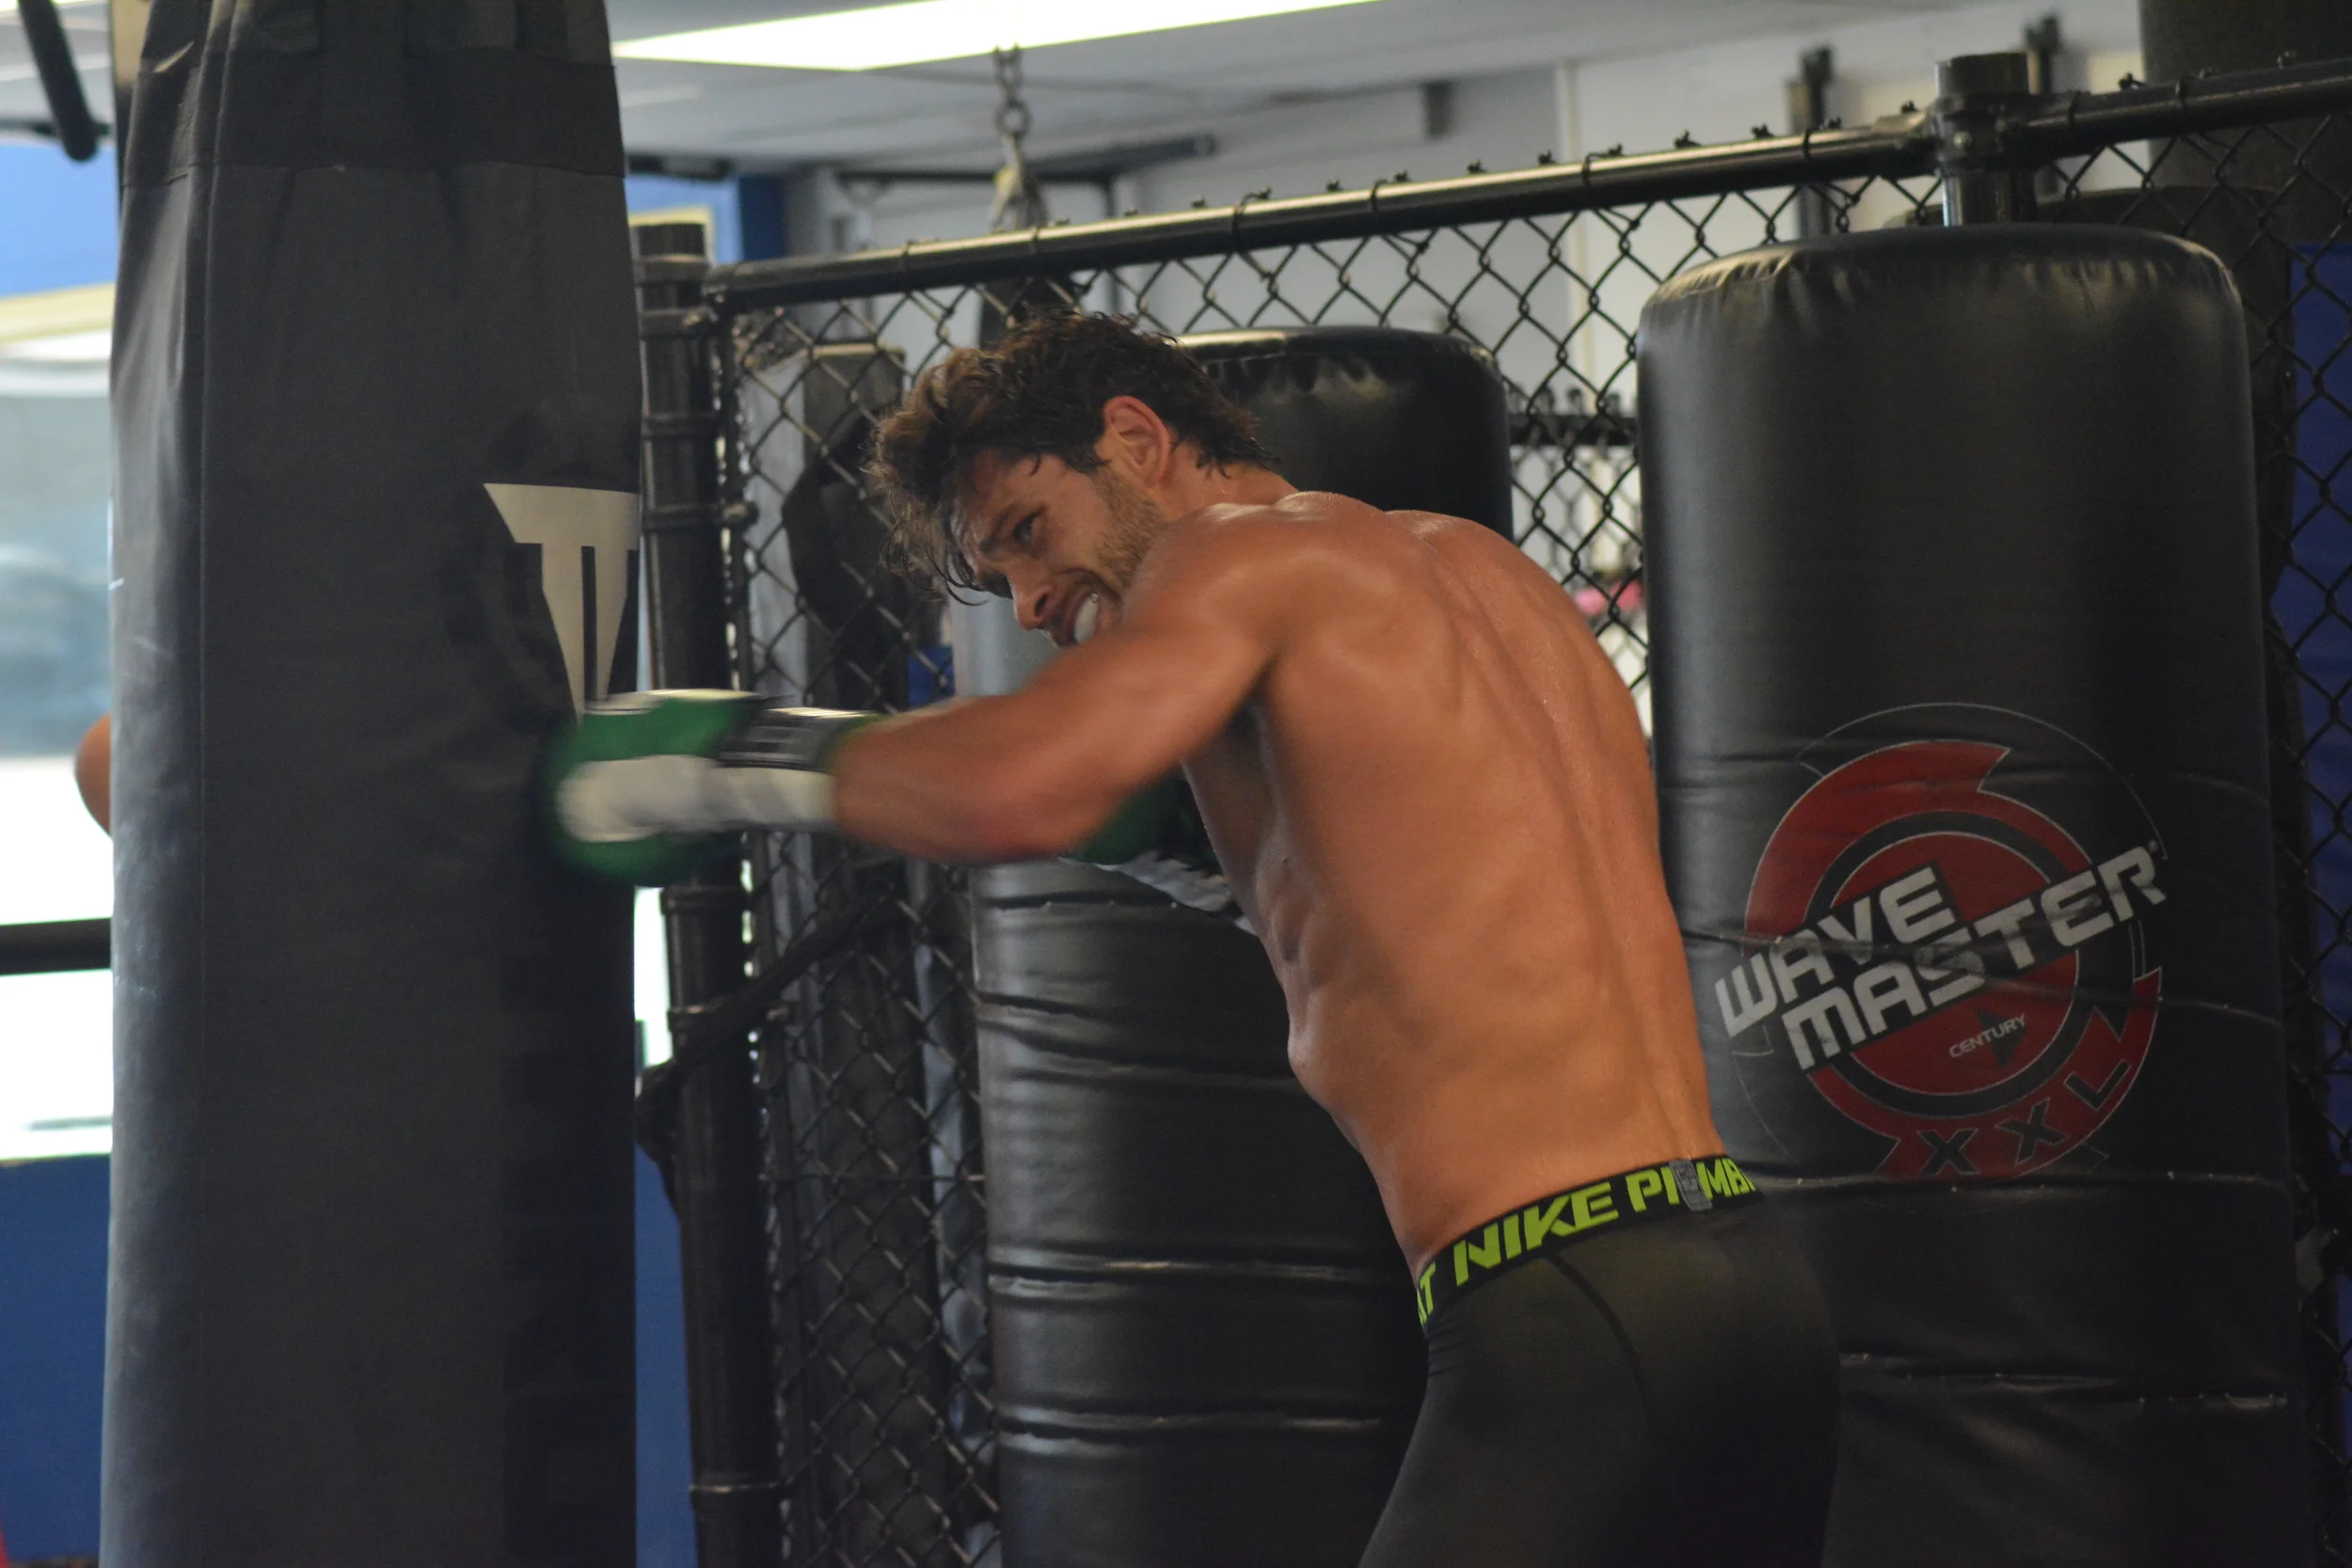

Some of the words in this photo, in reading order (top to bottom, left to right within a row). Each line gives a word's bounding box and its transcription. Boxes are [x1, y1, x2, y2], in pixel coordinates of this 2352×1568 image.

[1713, 865, 1957, 1039] WAVE
[1780, 845, 2166, 1071] MASTER
[1948, 1013, 2025, 1058] CENTURY
[1915, 1058, 2132, 1176] XXL
[1453, 1181, 1619, 1287] NIKE
